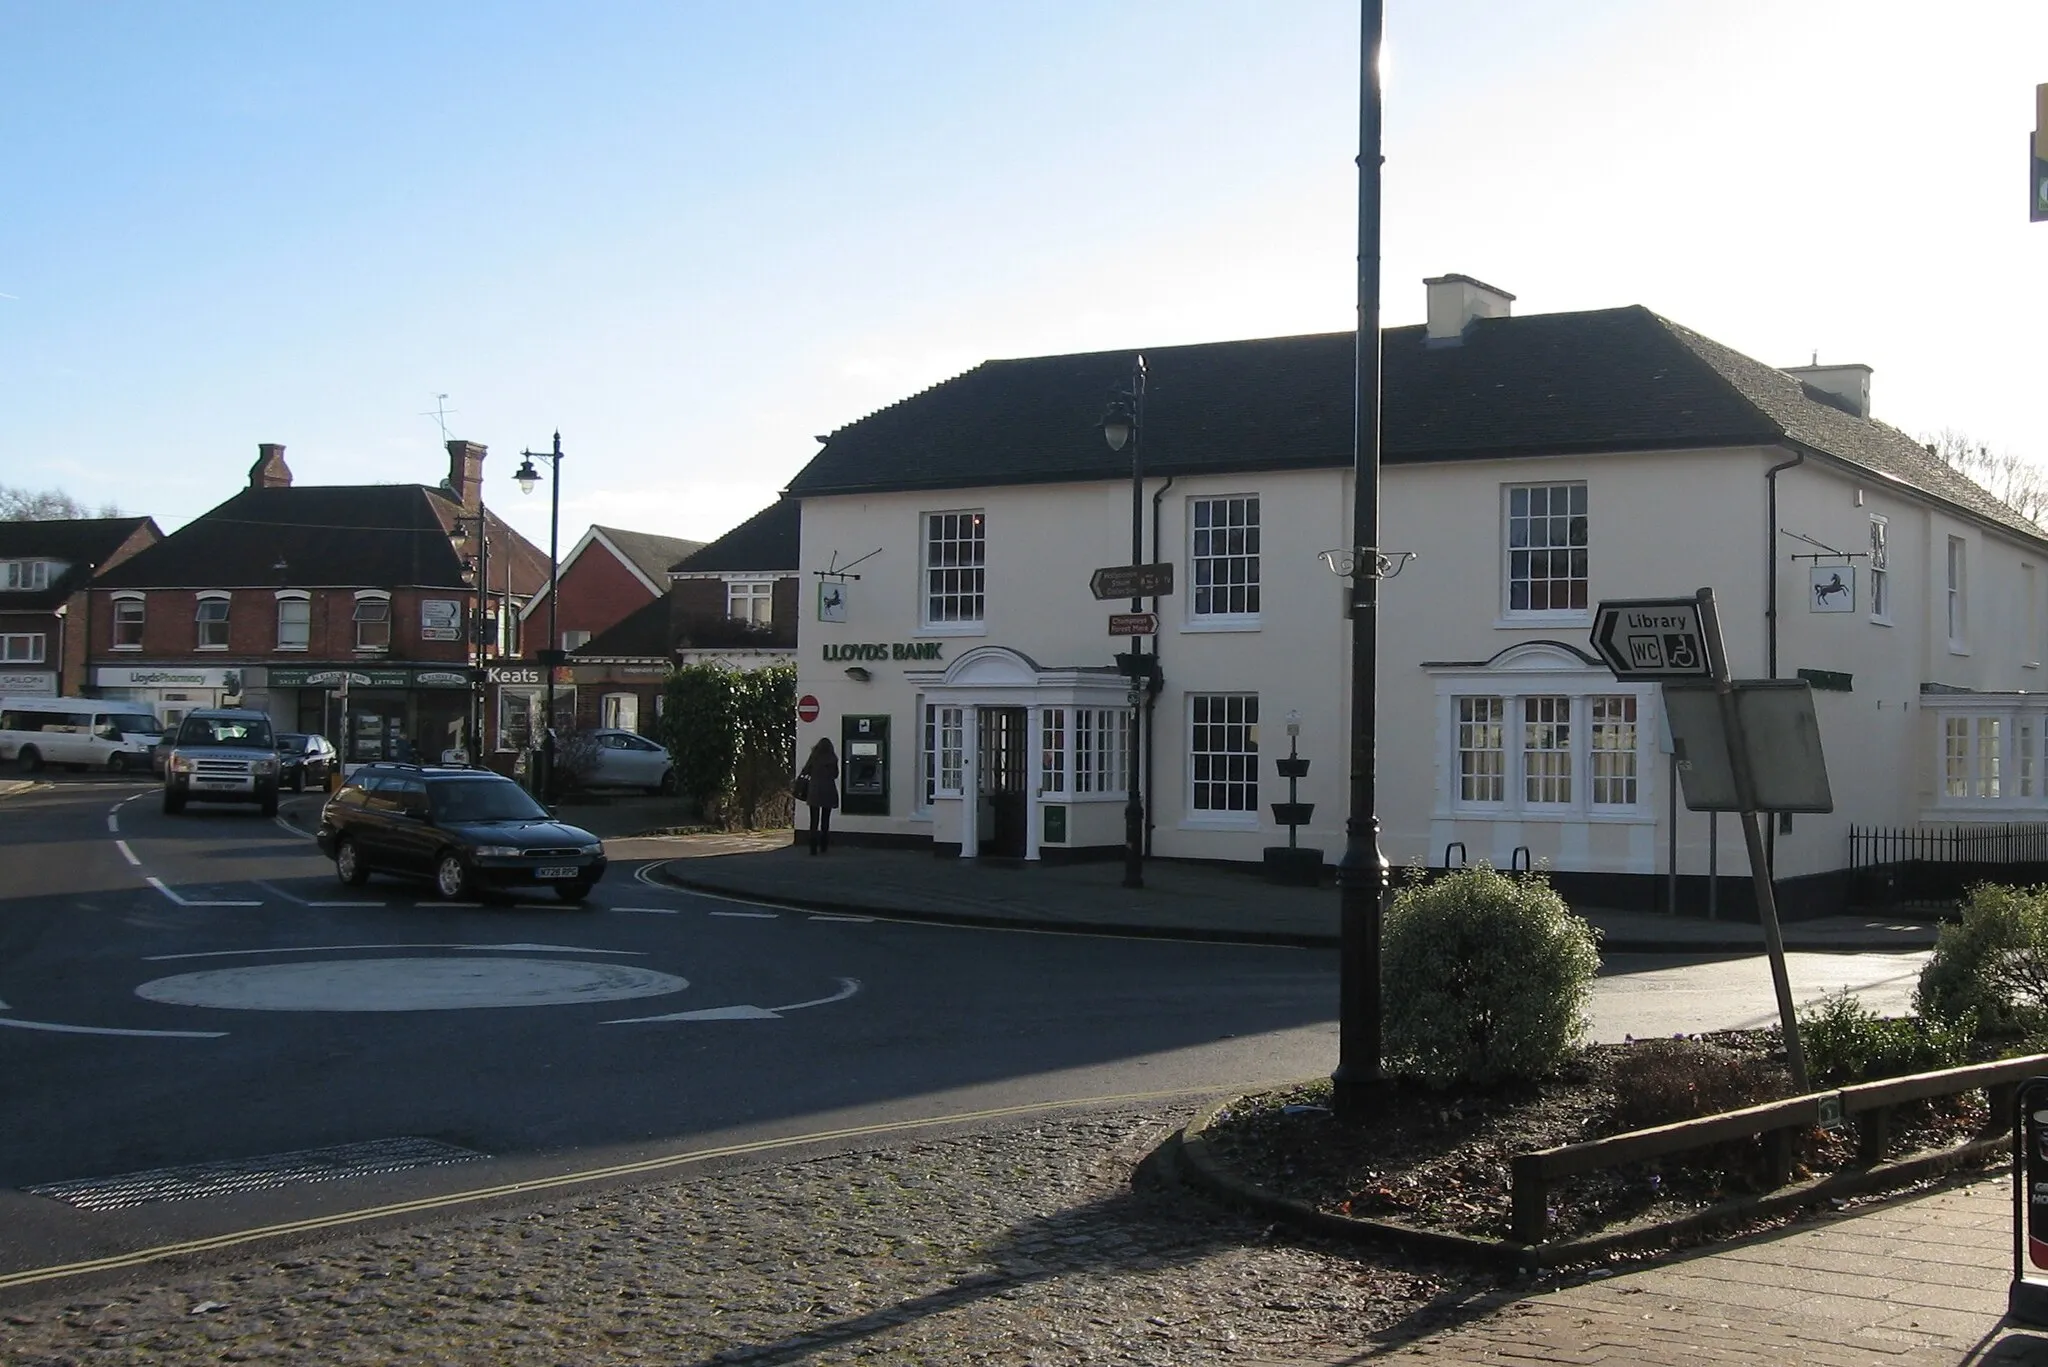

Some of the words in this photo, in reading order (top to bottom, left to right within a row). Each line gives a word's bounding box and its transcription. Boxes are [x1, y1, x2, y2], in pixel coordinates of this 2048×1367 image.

[1628, 613, 1686, 630] Library
[823, 643, 888, 661] LLOYDS
[892, 642, 943, 660] BANK
[1633, 642, 1659, 661] WC
[130, 671, 206, 686] LloydsPharmacy
[487, 667, 539, 683] Keats
